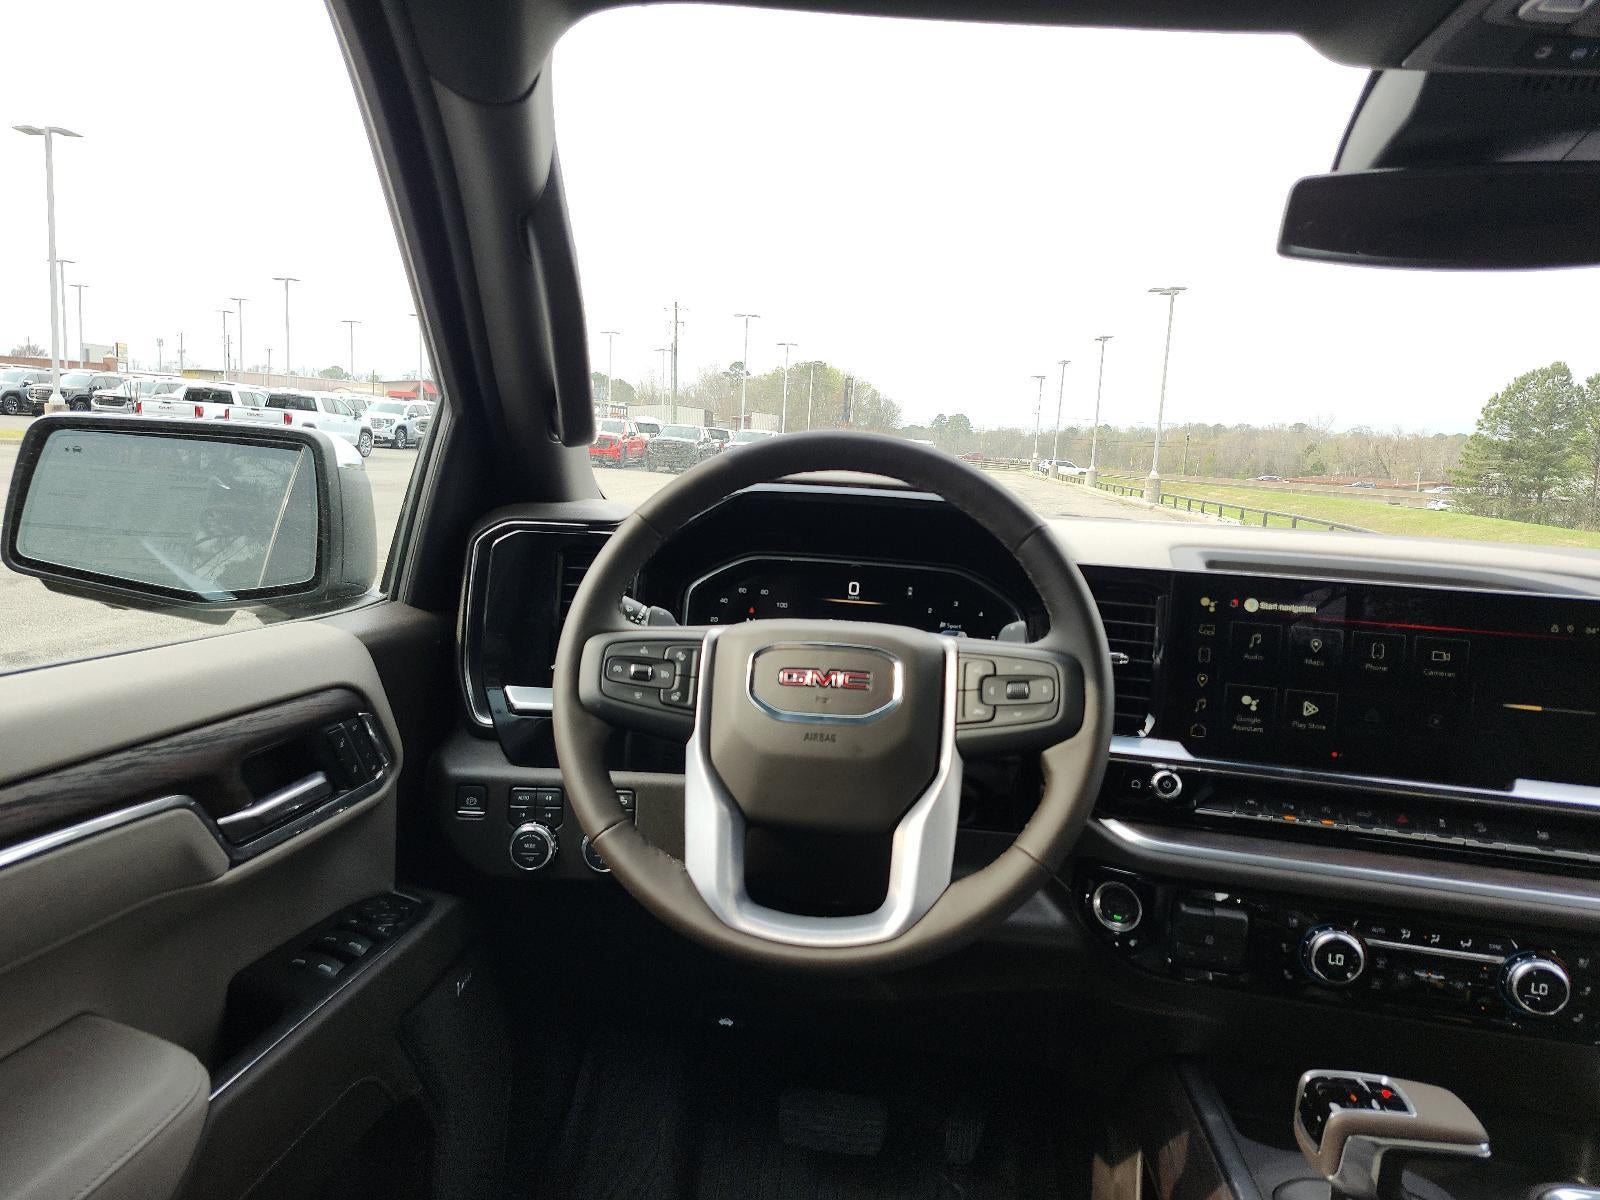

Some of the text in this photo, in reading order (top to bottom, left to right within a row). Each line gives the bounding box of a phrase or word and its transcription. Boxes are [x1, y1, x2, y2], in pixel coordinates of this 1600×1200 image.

[849, 582, 860, 595] 0
[1260, 602, 1317, 613] Start navigation
[946, 622, 962, 630] Sport
[1364, 663, 1389, 672] Phone
[778, 667, 873, 691] GMC
[803, 732, 837, 743] AIRBAG
